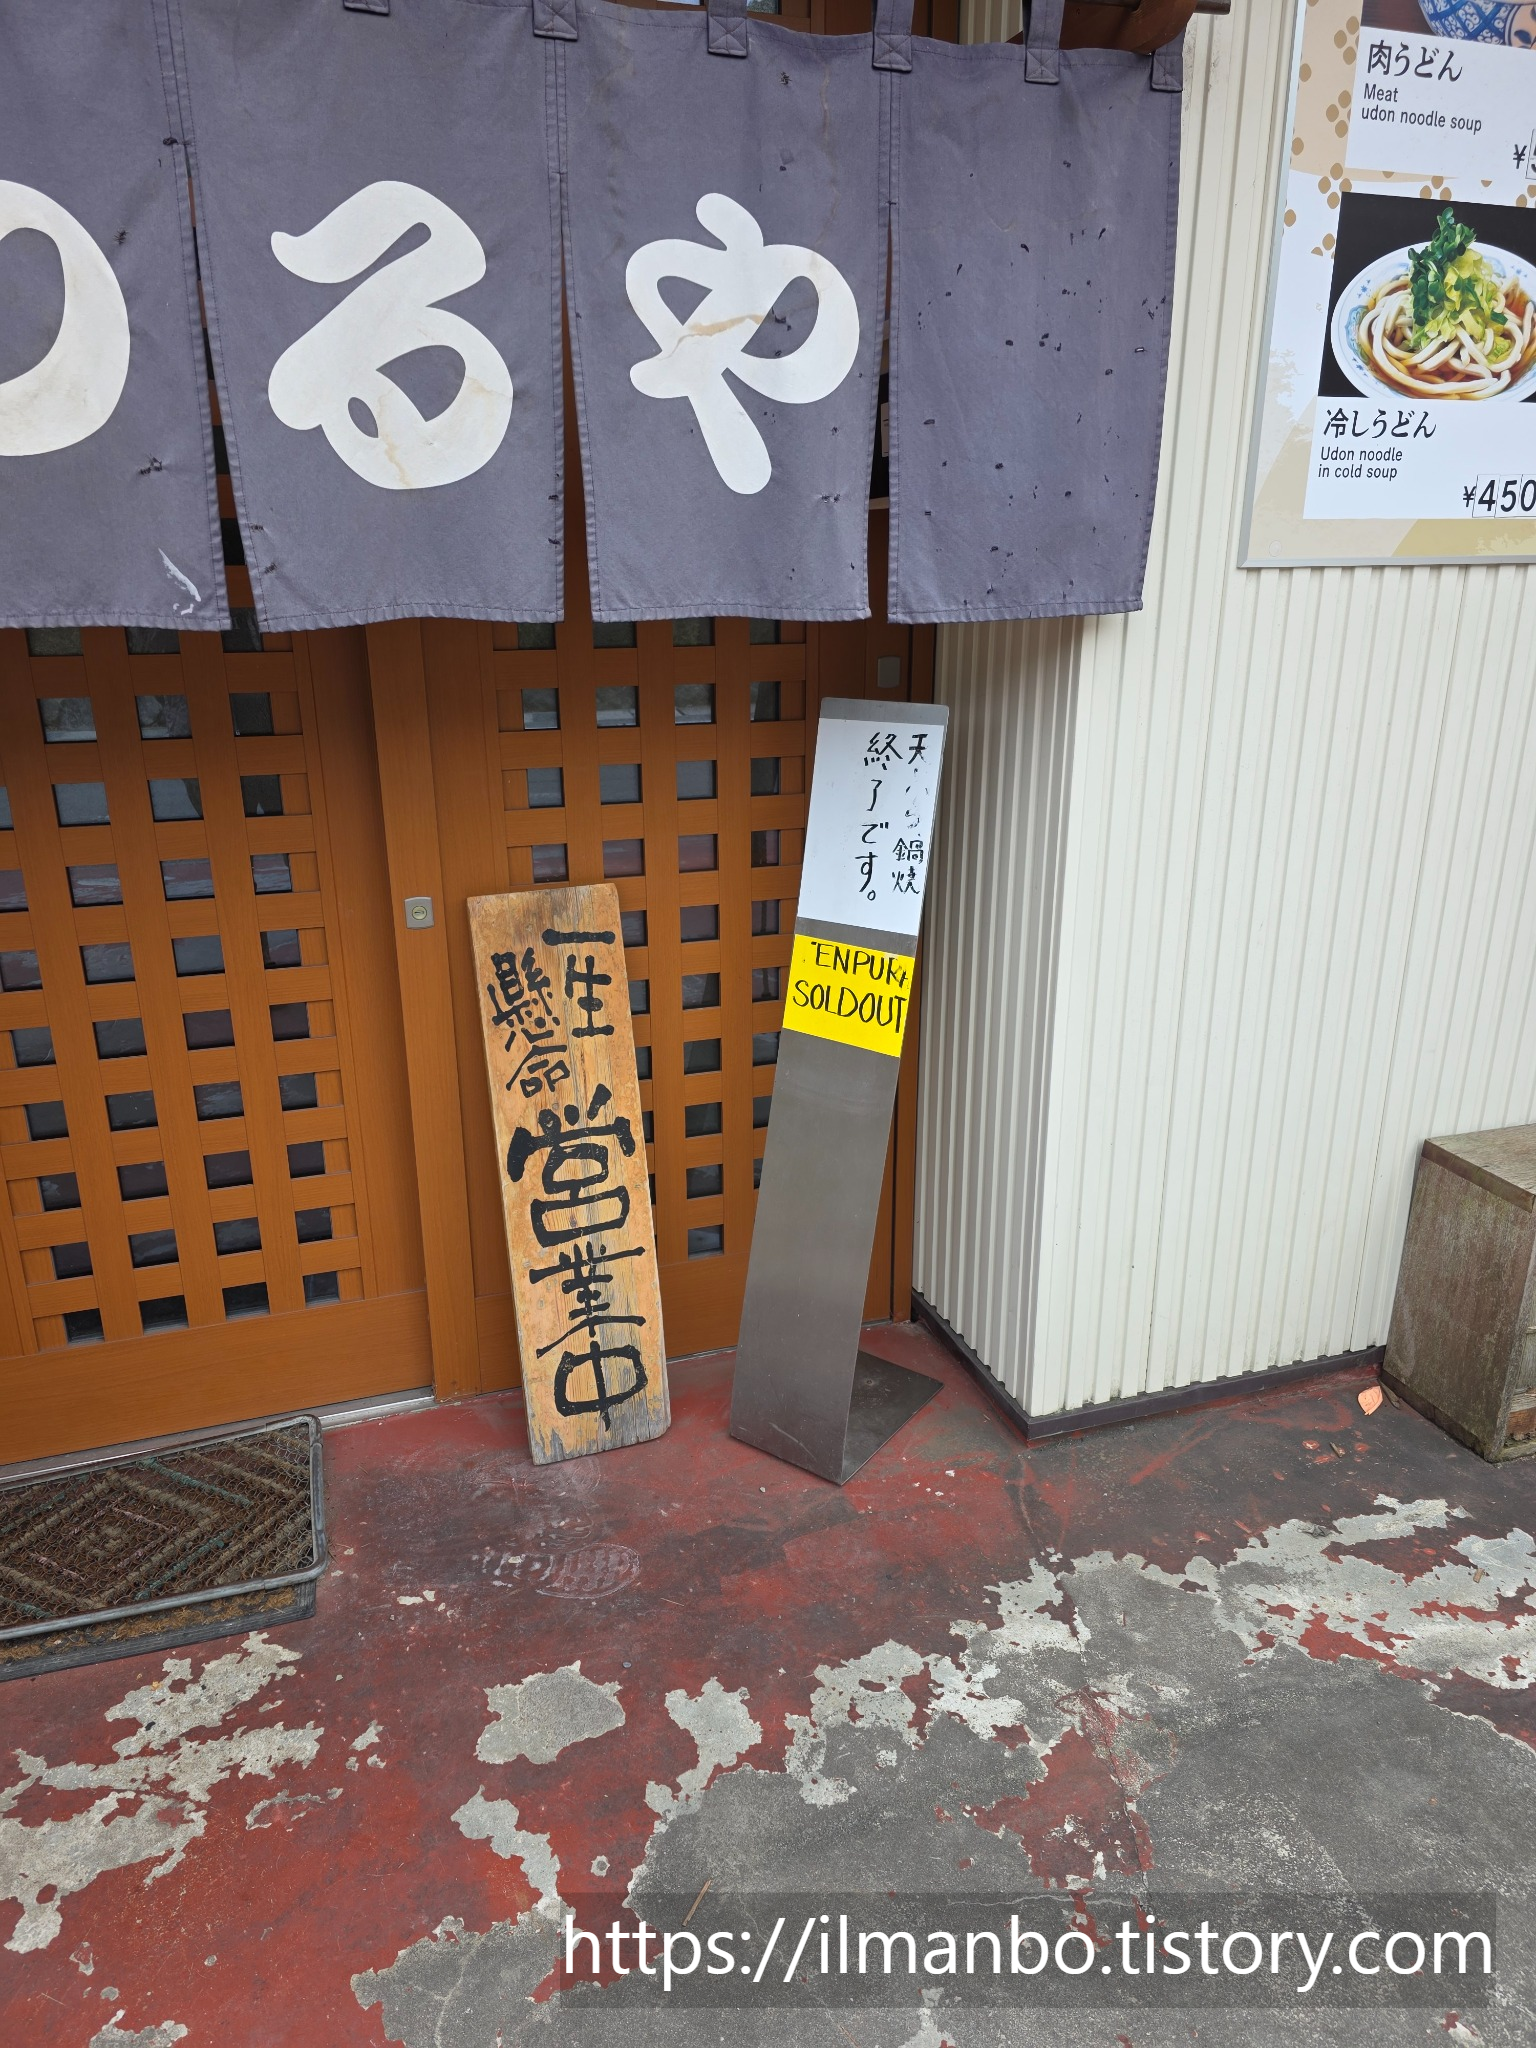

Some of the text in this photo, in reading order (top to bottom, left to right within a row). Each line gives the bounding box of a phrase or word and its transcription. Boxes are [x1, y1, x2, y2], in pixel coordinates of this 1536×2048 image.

[1367, 39, 1463, 82] 肉うどん
[1363, 82, 1399, 103] Meat
[1361, 104, 1482, 136] udon noodle soup
[1323, 407, 1437, 439] 冷しうどん
[1320, 446, 1403, 462] Udon noodle
[1318, 463, 1398, 482] in cold soup
[1462, 479, 1536, 513] ¥450
[855, 731, 904, 902] 終了です。
[810, 941, 910, 989] ENPUR
[506, 1084, 649, 1433] 営業中
